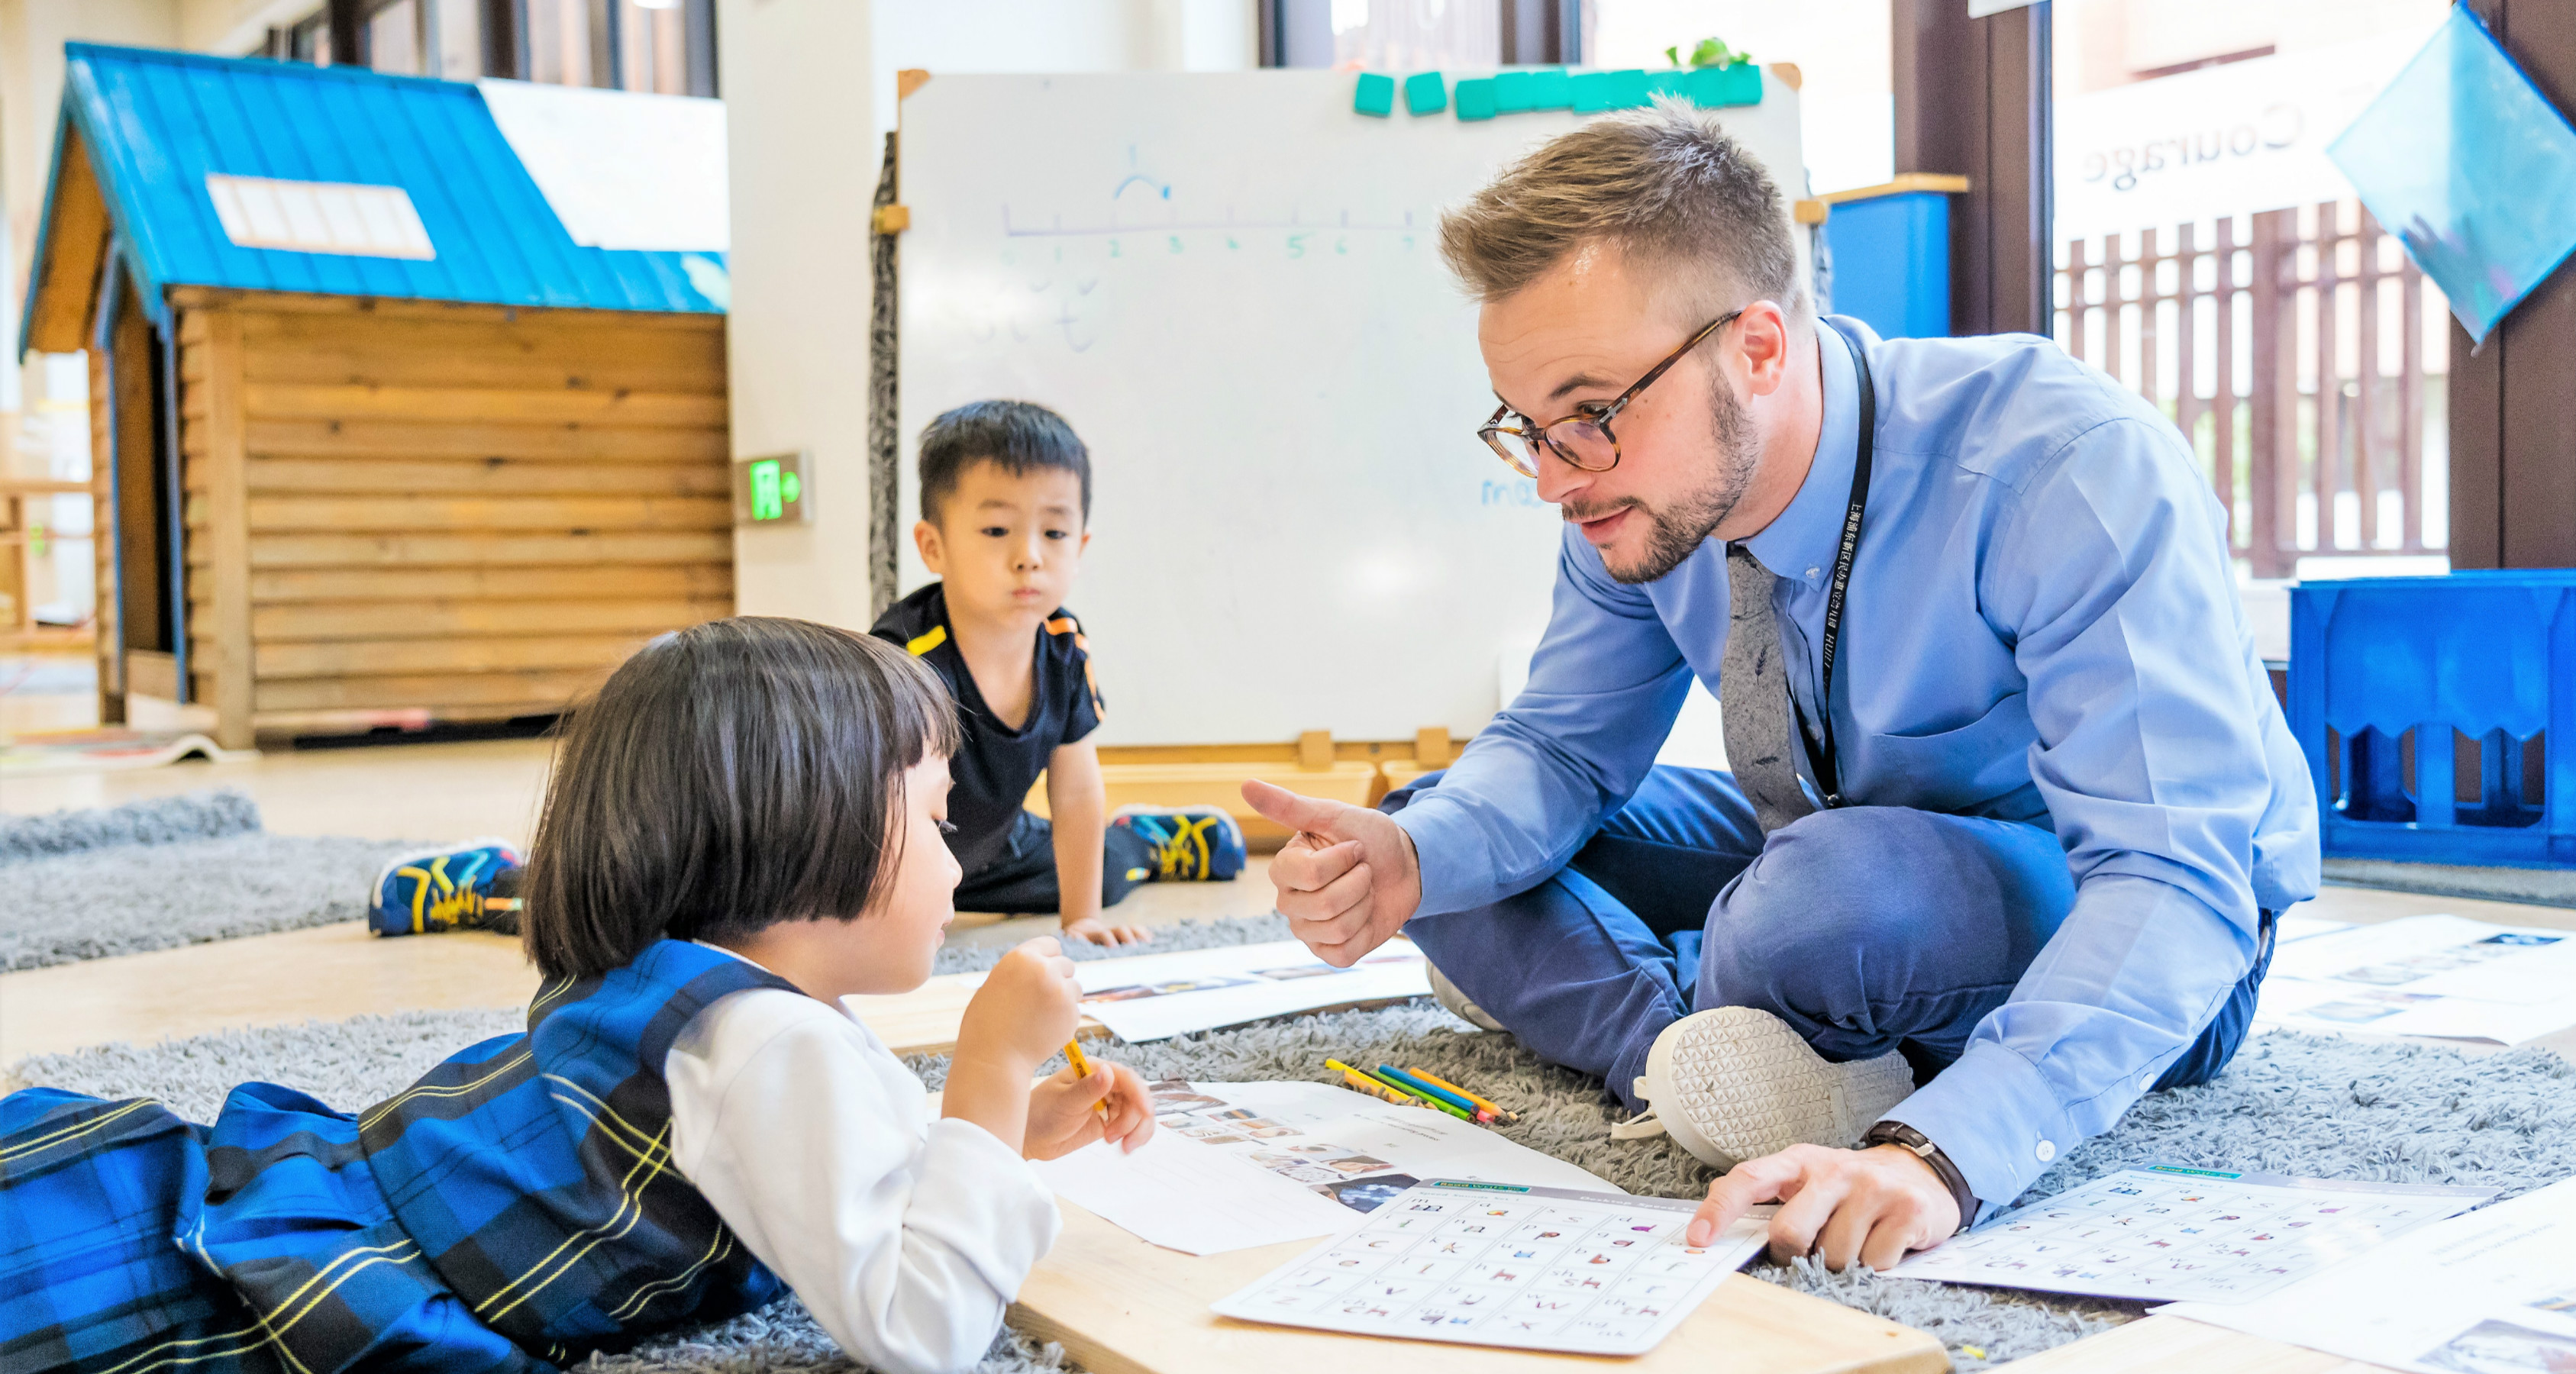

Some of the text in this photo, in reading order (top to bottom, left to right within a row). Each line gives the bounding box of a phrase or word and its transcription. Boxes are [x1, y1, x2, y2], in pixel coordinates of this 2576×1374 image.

[1108, 238, 1123, 258] 2
[1167, 234, 1184, 254] 3
[1286, 230, 1317, 260] 5
[1335, 234, 1348, 255] 6
[1580, 1195, 1632, 1206] Desktop
[1635, 1202, 1676, 1211] Speed
